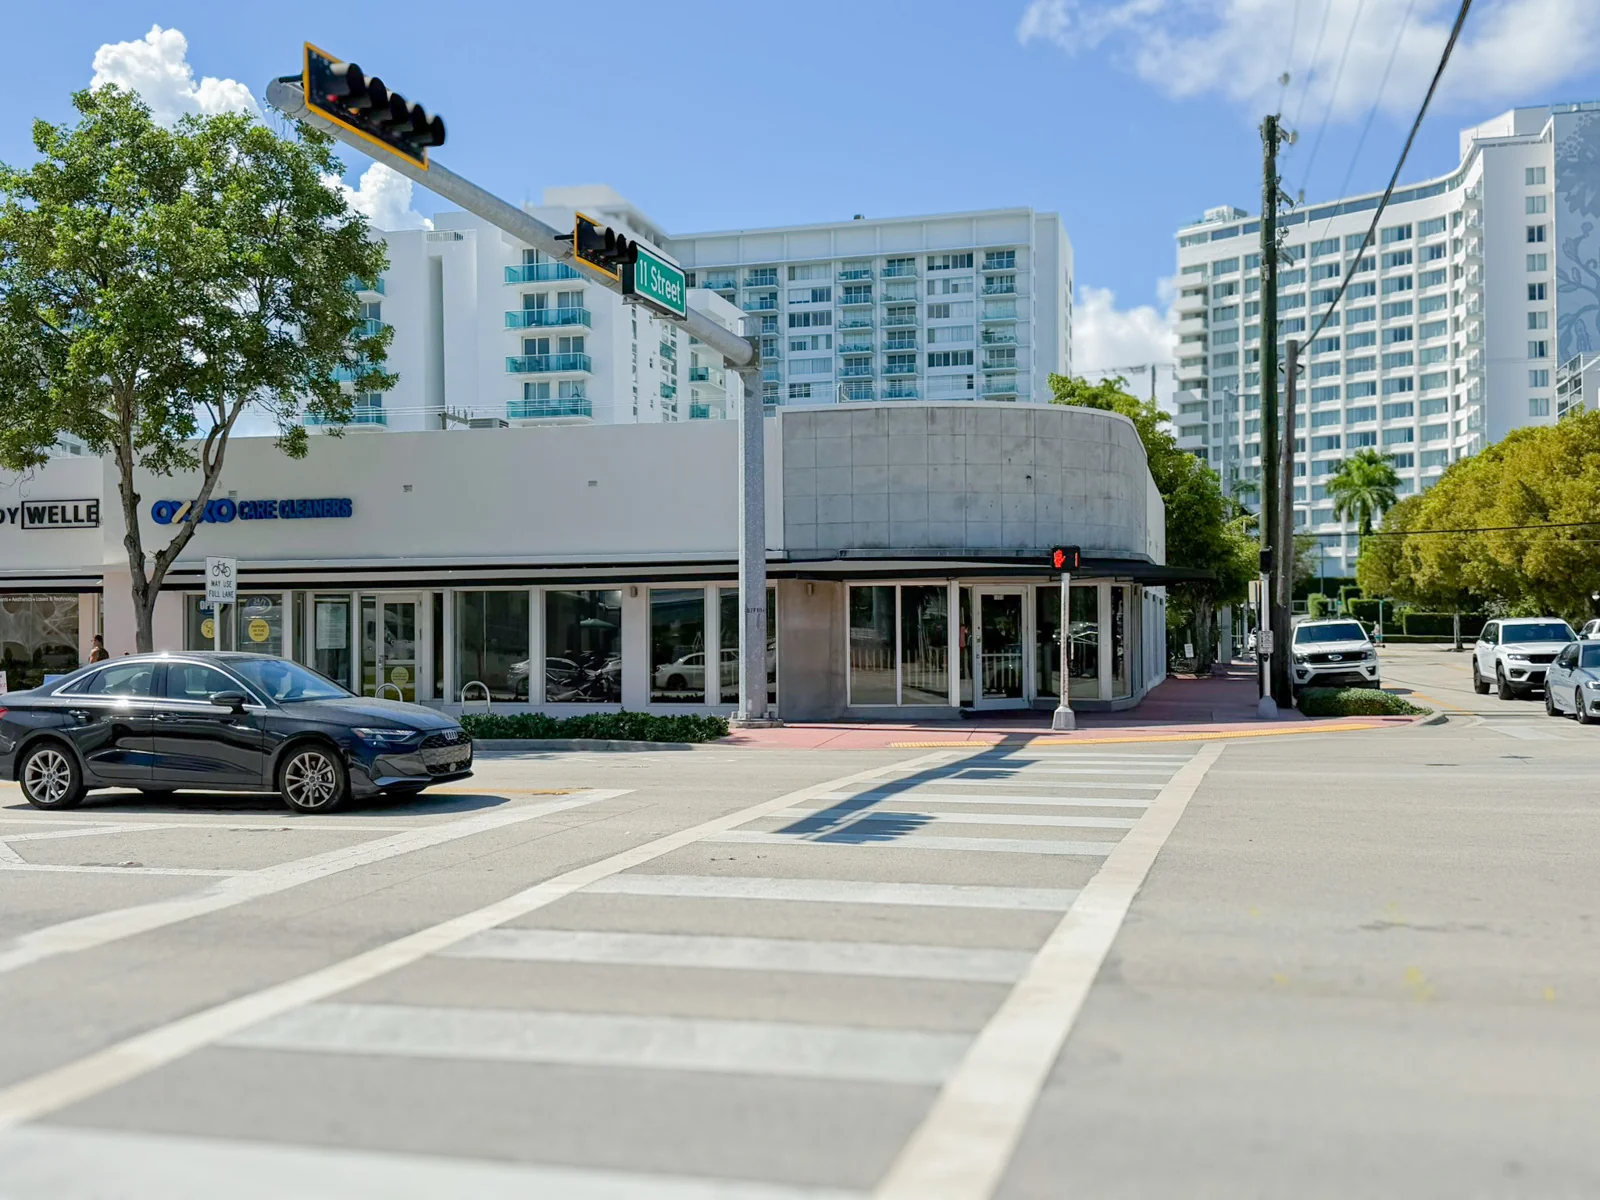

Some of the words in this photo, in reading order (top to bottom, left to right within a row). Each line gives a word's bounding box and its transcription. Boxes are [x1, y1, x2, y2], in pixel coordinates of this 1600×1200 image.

[639, 259, 647, 287] 11
[650, 265, 681, 305] Street
[26, 505, 99, 524] WELLE
[238, 500, 279, 520] CARE
[279, 498, 352, 519] CLEANERS
[223, 580, 232, 588] USE
[209, 590, 220, 598] FULL
[222, 590, 234, 598] LANE
